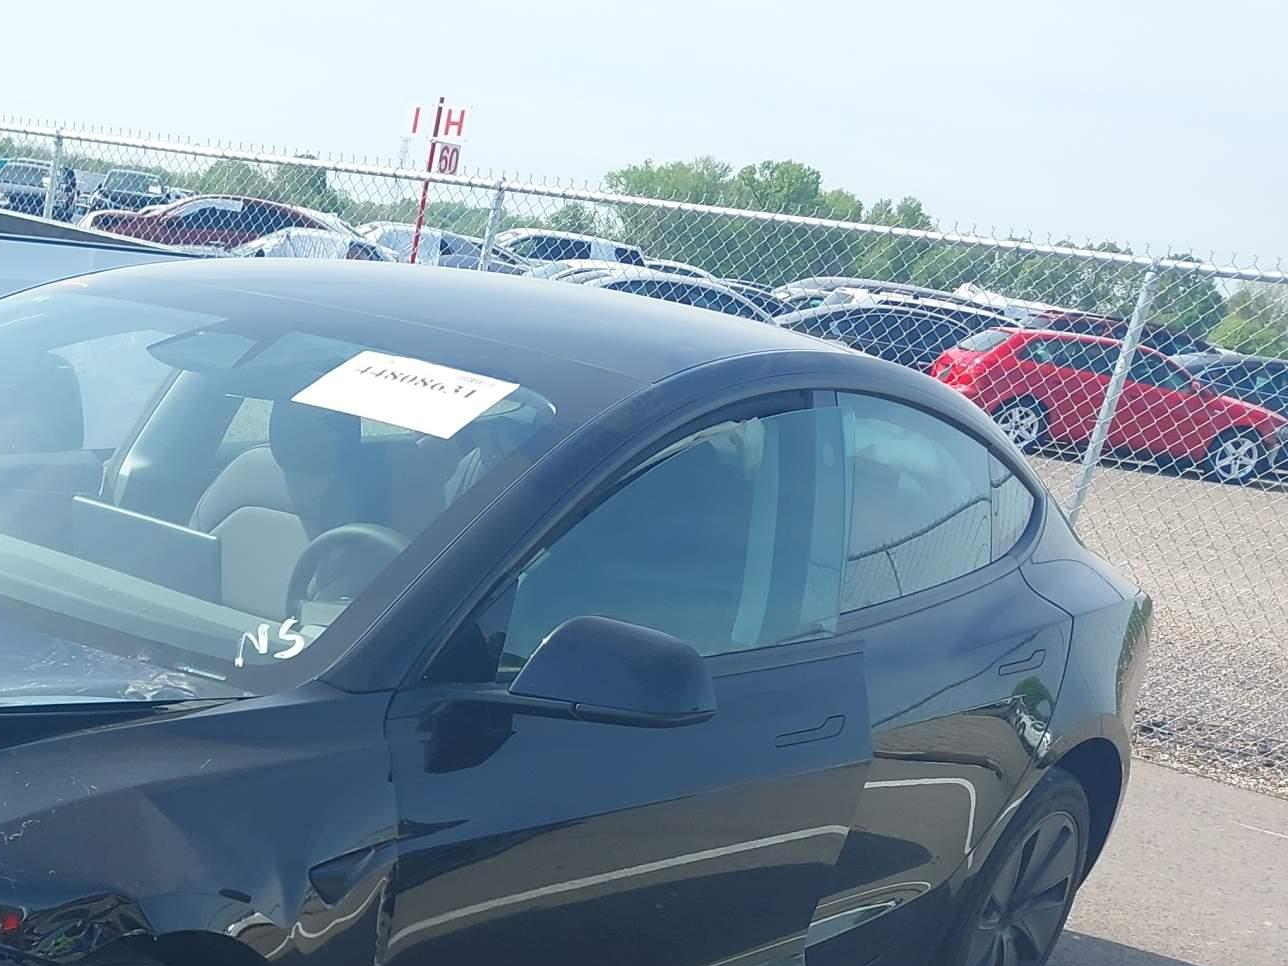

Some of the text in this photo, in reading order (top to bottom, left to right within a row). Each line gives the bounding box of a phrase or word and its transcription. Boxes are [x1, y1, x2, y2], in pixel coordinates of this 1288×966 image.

[444, 109, 465, 136] H
[439, 145, 459, 174] 60
[354, 365, 478, 399] 44808631
[233, 615, 306, 668] NS
